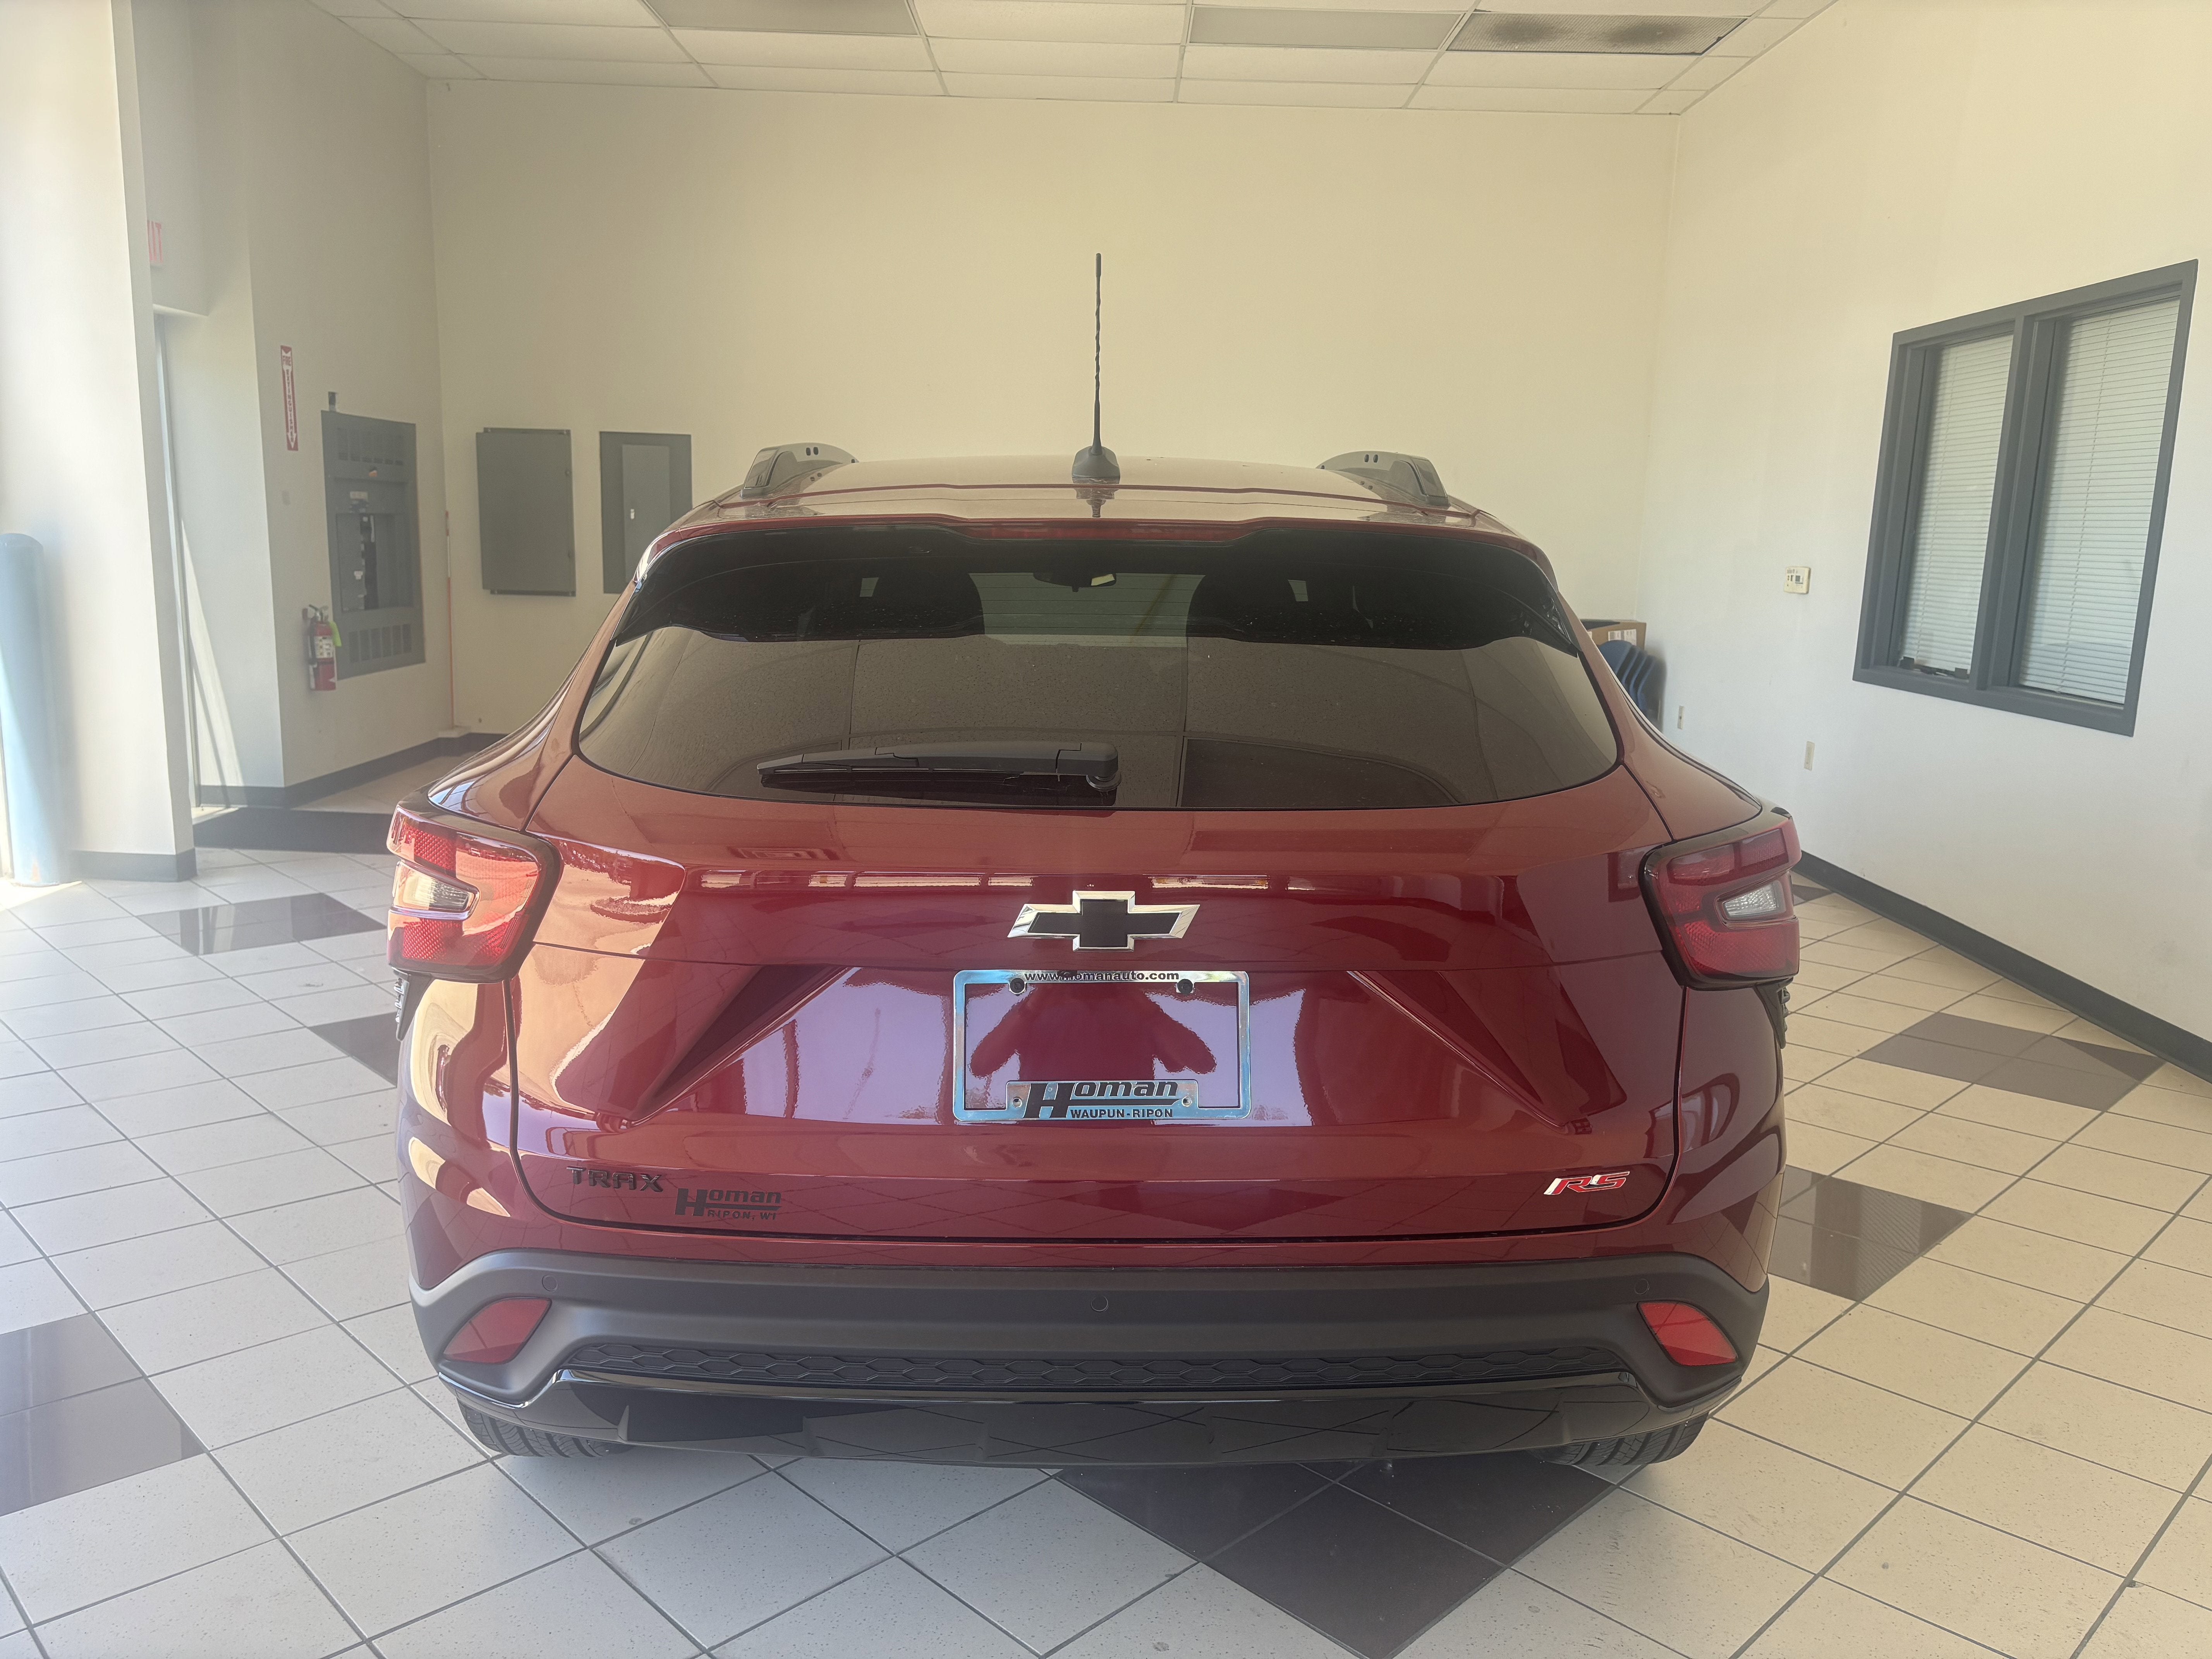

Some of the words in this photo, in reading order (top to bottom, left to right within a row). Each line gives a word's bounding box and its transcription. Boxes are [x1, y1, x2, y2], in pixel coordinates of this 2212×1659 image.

[147, 220, 163, 263] IT
[282, 355, 291, 366] FIRE
[1022, 1082, 1179, 1118] Homan
[566, 1166, 663, 1192] TRAX
[1544, 1171, 1630, 1195] RS
[675, 1188, 782, 1216] Homan
[707, 1209, 755, 1221] RIPON,
[760, 1212, 776, 1220] WI
